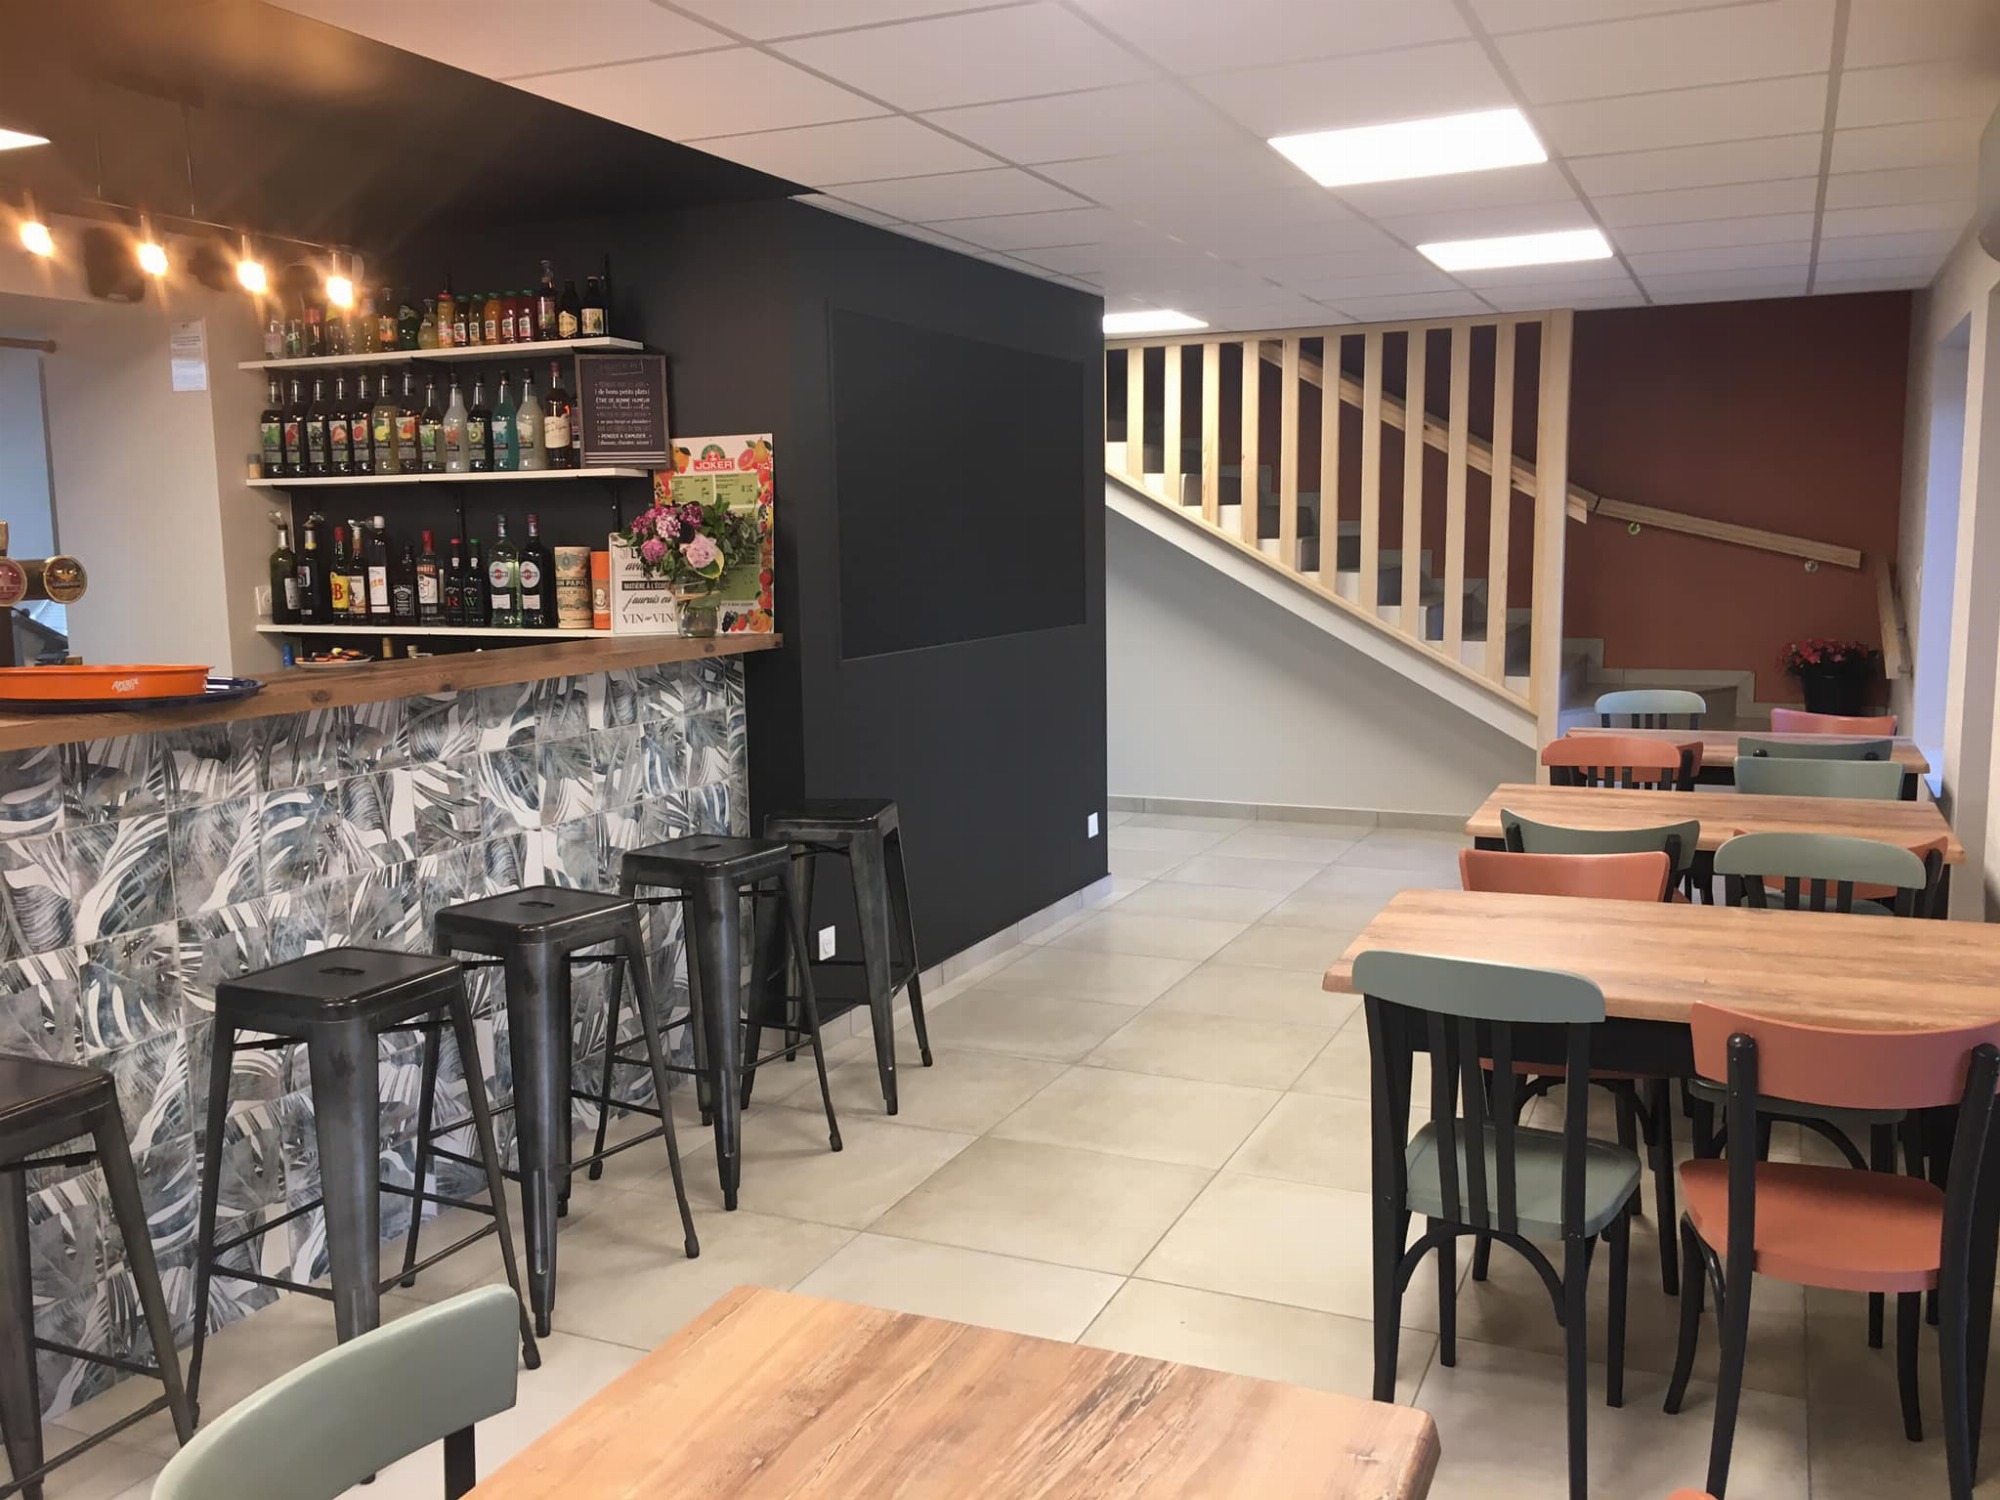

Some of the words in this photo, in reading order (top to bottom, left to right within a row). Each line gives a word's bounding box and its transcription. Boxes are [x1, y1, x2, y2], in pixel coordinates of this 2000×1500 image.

[695, 461, 733, 470] JOKER
[623, 614, 644, 624] VIN
[652, 613, 674, 623] VIN
